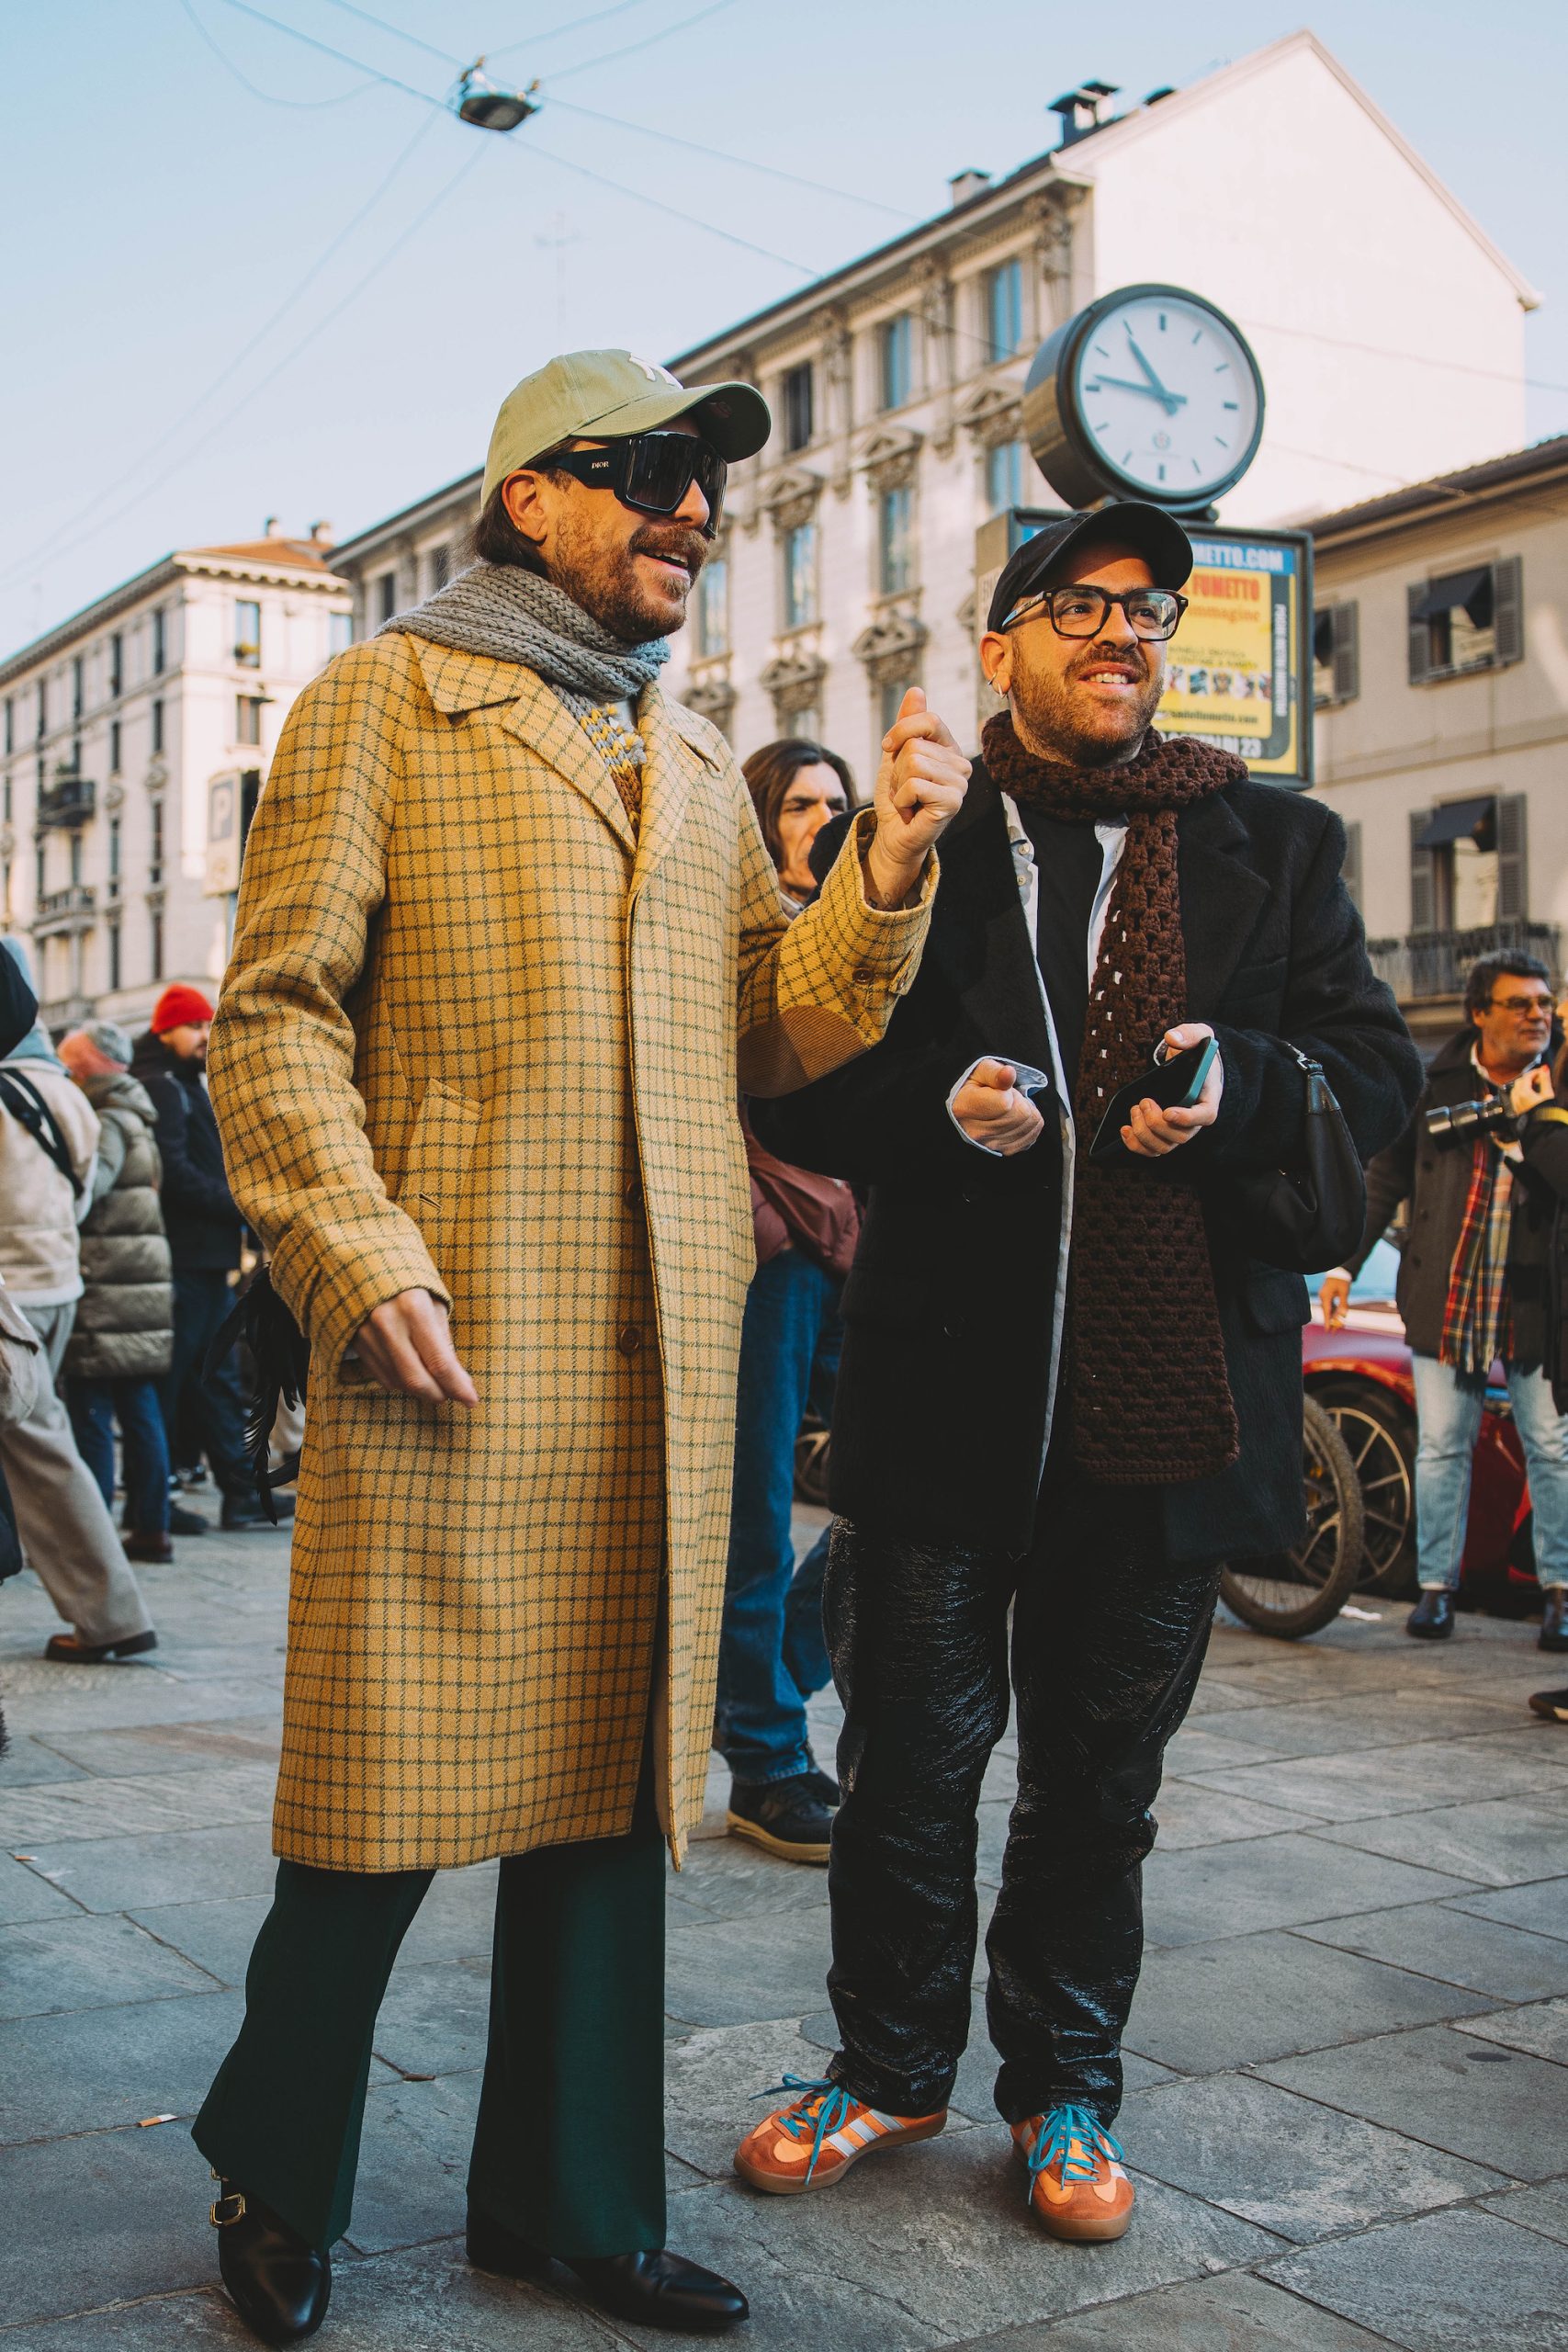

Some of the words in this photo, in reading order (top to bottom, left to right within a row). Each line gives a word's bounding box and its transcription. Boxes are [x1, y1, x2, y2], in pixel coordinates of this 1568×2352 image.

[592, 460, 609, 469] DIOR
[1192, 543, 1284, 572] METTO.COM
[1193, 573, 1259, 602] FUMETTO
[1240, 738, 1262, 759] 23
[213, 788, 232, 838] P
